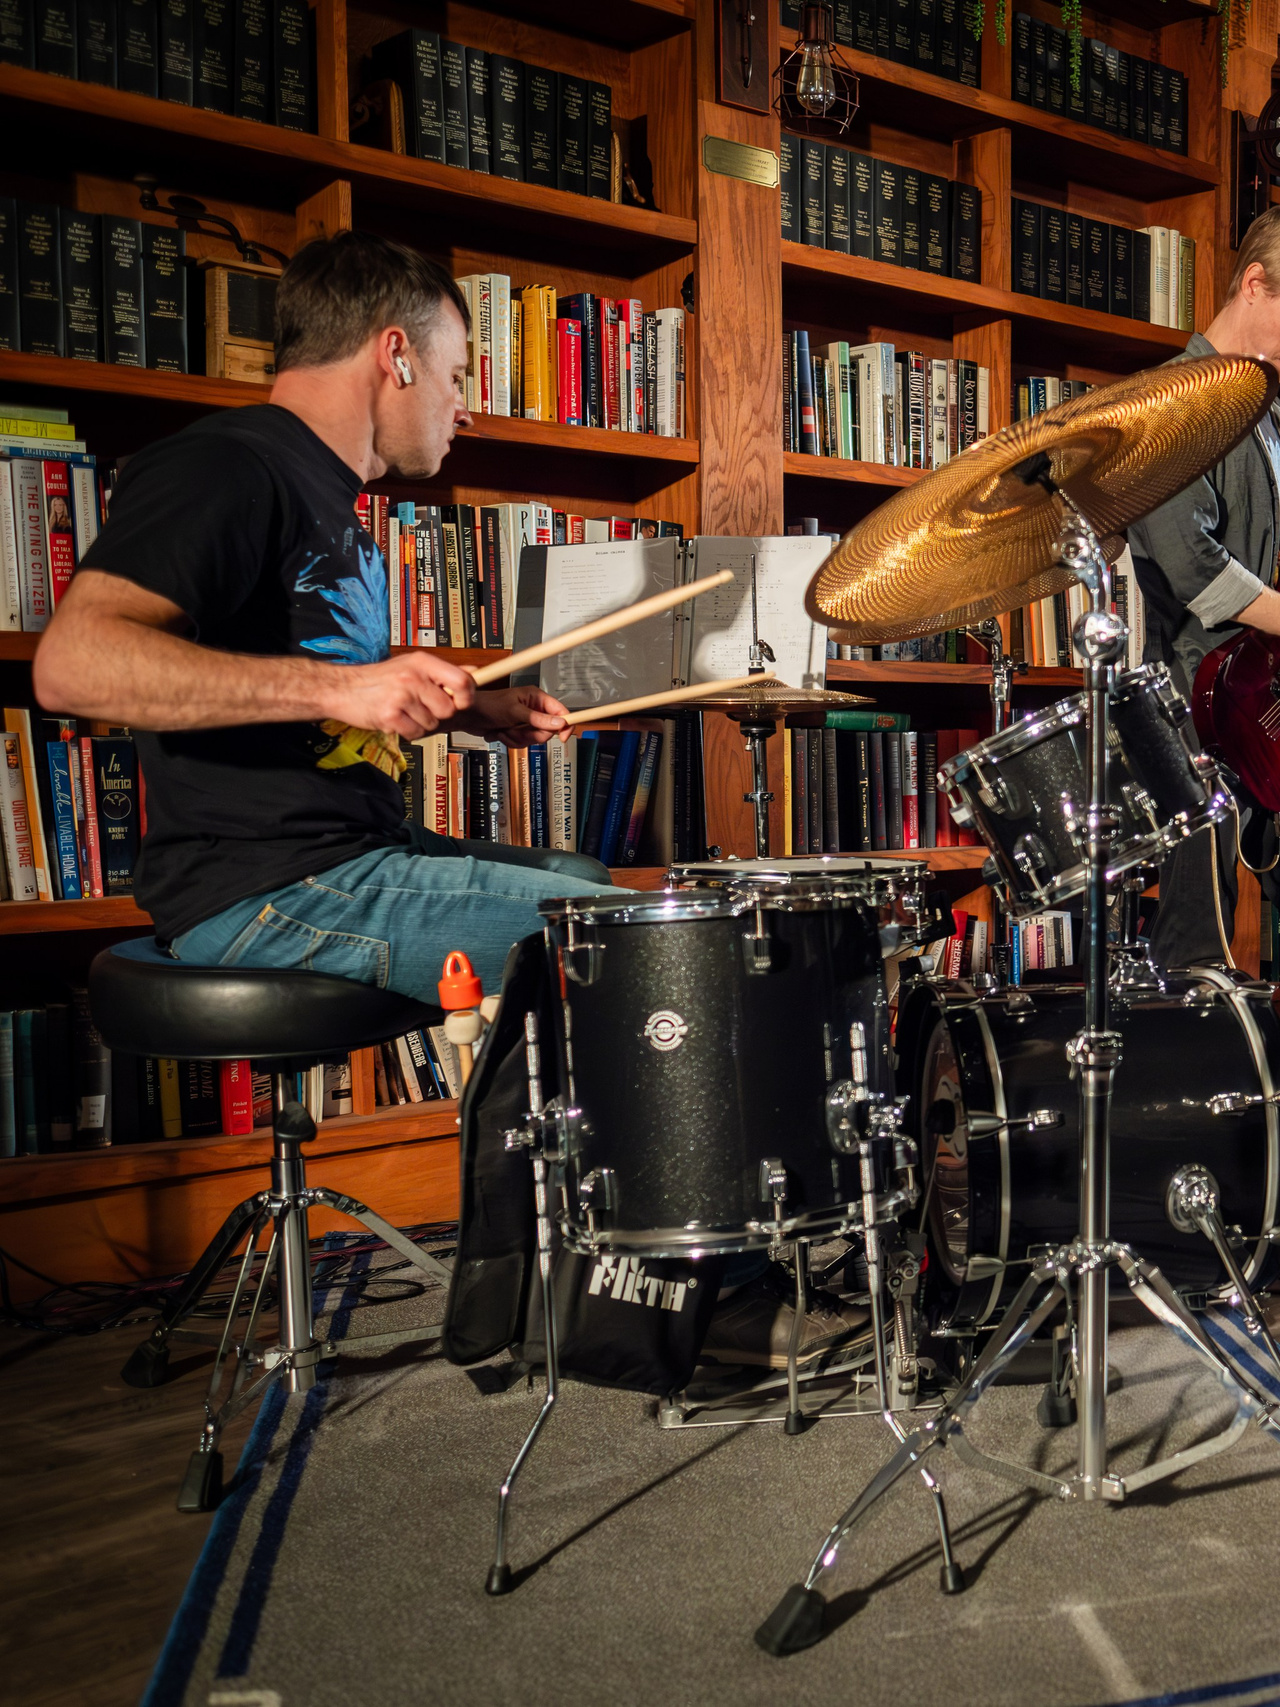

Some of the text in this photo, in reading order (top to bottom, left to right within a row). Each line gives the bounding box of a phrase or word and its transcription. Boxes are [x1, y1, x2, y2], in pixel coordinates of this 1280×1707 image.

[498, 287, 508, 387] CASE TRUMP
[634, 303, 642, 388] DENNIS PRAGER
[646, 317, 655, 380] BLACKLASH
[910, 372, 924, 409] ROBERT
[964, 380, 975, 423] ROAD TO
[910, 424, 924, 442] LEE
[911, 414, 924, 422] E.
[47, 482, 67, 490] COULTER
[82, 481, 91, 516] AMERICAN
[3, 505, 15, 544] AMERICA
[27, 485, 45, 616] THE DYING CITIZEN
[446, 530, 458, 589] HARVEST SORROW
[8, 567, 18, 609] RETREAT
[101, 766, 132, 790] America
[108, 753, 121, 773] In
[489, 753, 497, 799] BEOWULF
[859, 777, 868, 787] T
[81, 748, 96, 847] The Emotional House
[553, 746, 563, 833] THE SOURCE AND THE VISION
[11, 800, 32, 868] UNITED IN HATE
[52, 760, 76, 879] lovable LIVABLE HOME
[406, 1031, 427, 1067] OSENBERG
